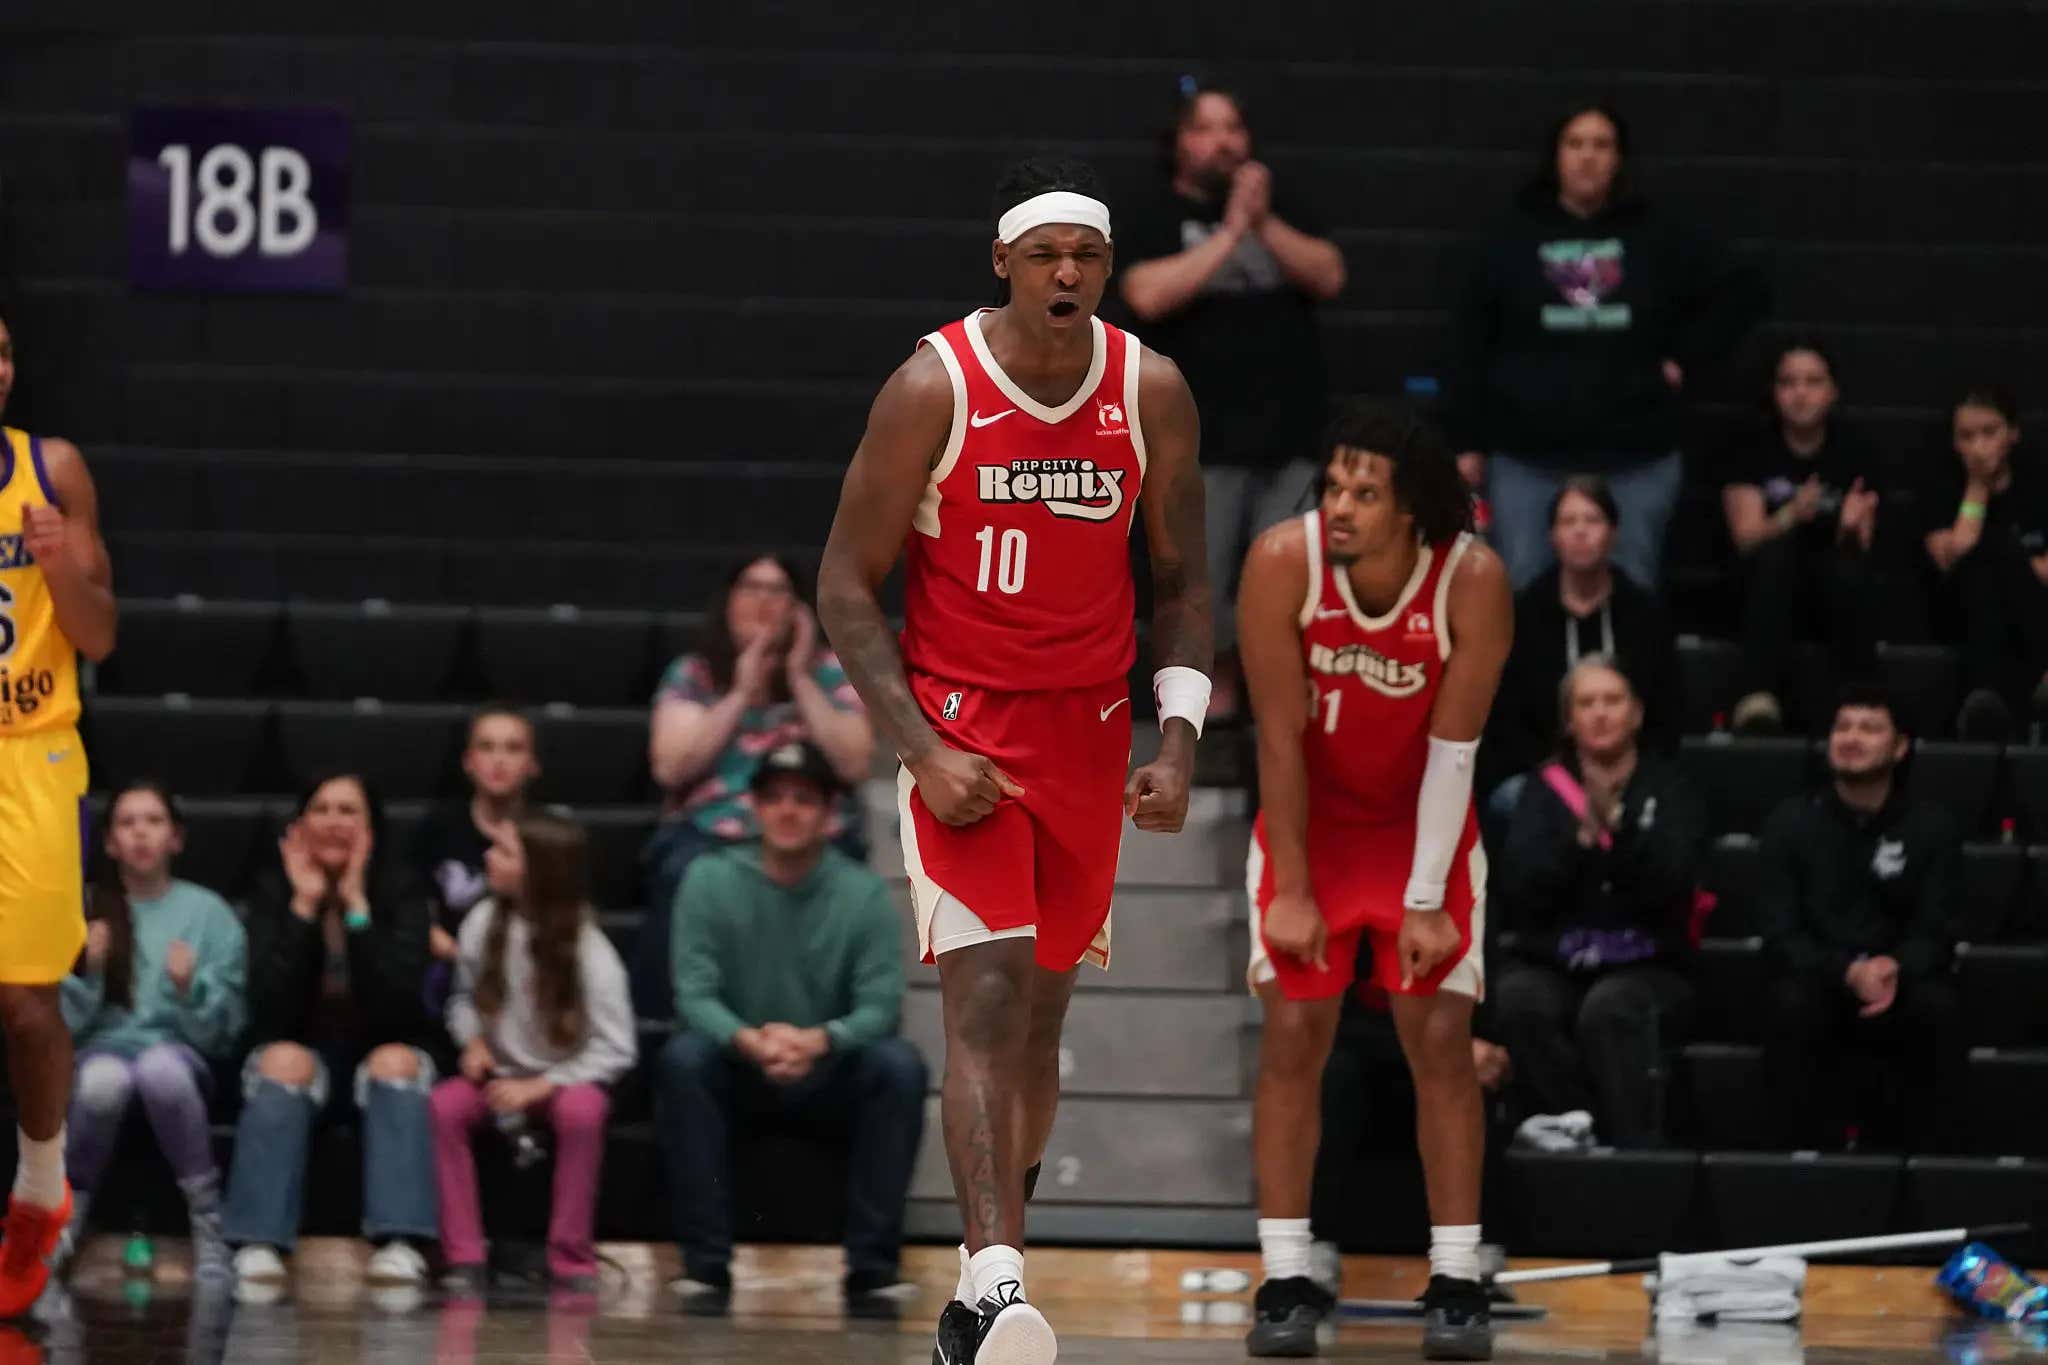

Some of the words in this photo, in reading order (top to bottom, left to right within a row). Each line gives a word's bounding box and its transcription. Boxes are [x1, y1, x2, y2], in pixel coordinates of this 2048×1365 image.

[157, 144, 319, 257] 18B
[976, 460, 1124, 521] Remix
[1011, 460, 1039, 472] RIP
[1042, 459, 1078, 471] CITY
[975, 525, 1028, 594] 10
[1056, 1154, 1082, 1187] 2
